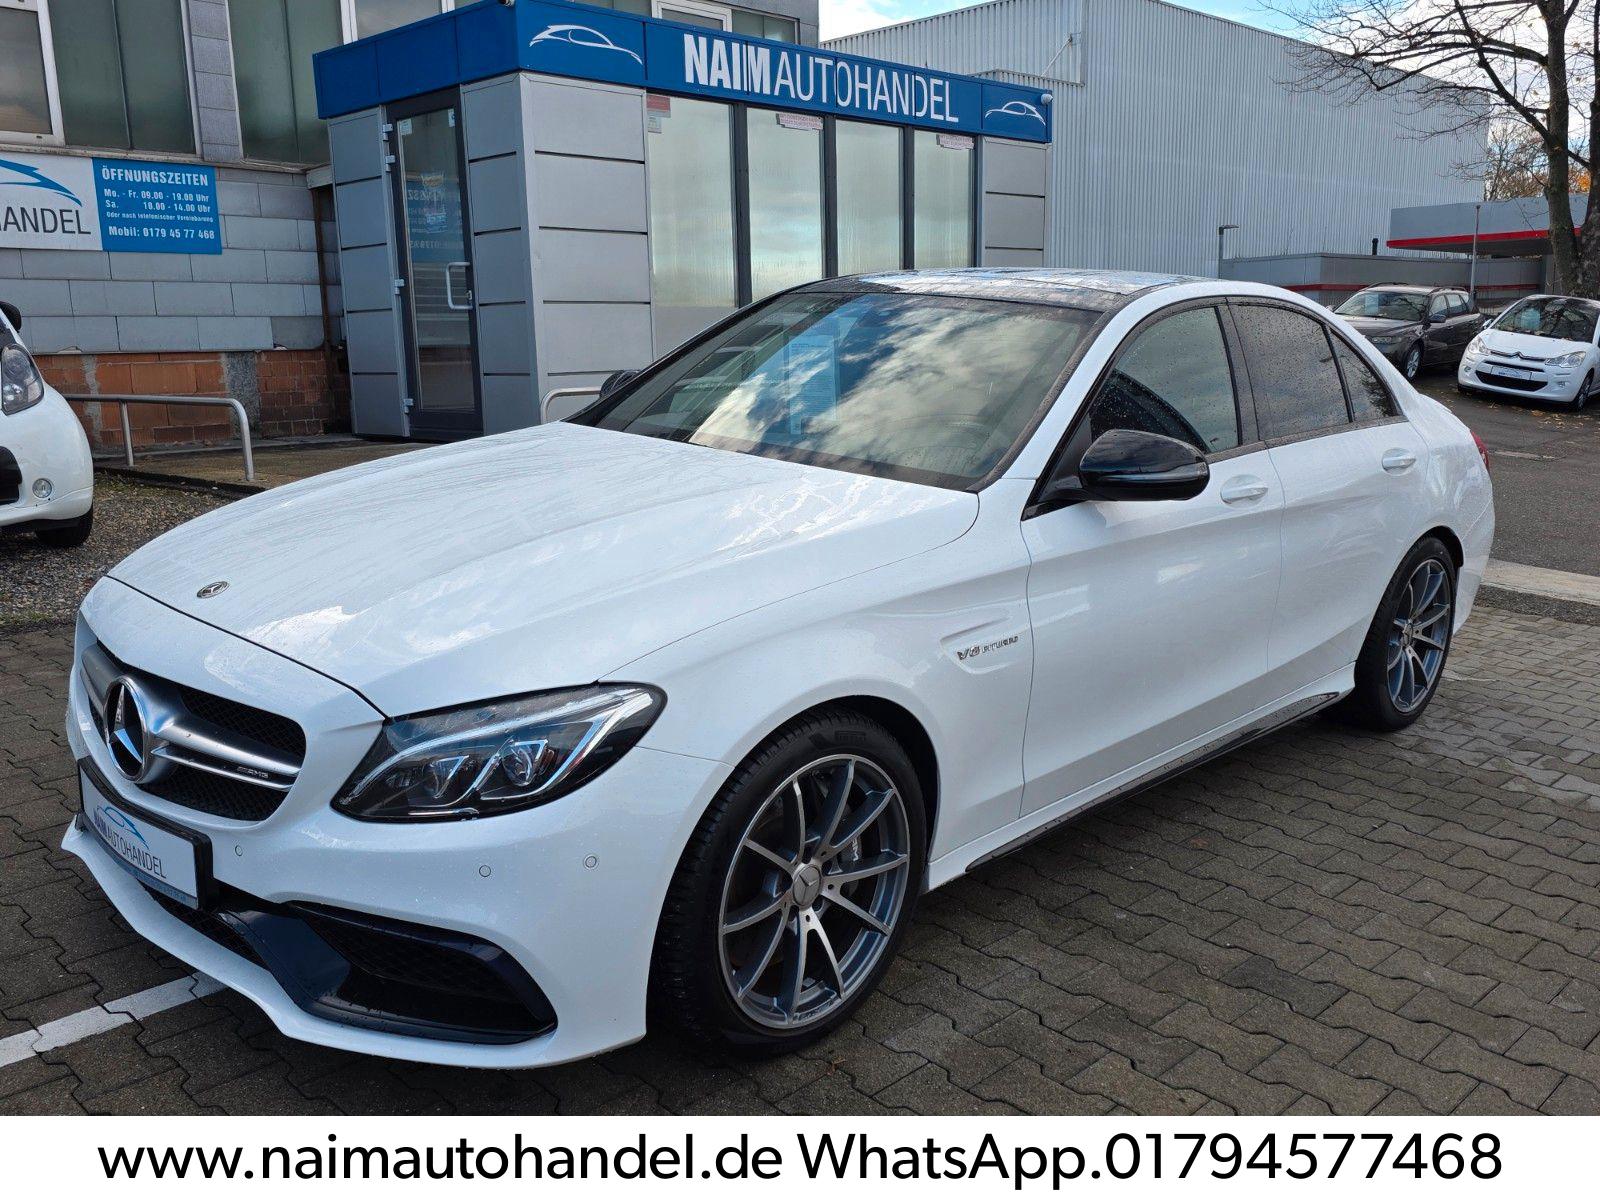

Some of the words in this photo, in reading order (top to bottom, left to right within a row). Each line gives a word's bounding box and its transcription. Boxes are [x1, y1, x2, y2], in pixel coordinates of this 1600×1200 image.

[683, 33, 771, 95] NAIM
[774, 51, 960, 123] AUTOHANDEL
[101, 164, 209, 187] ÖFFNUNGSZEITEN
[104, 188, 120, 198] Mo.
[128, 189, 139, 198] Fr.
[141, 190, 164, 200] 09.00
[196, 193, 209, 203] Uhr
[105, 199, 119, 209] Sa.
[143, 201, 166, 211] 10.00
[174, 203, 196, 213] 14.00
[197, 204, 211, 213] Uhr
[106, 211, 120, 219] Oder
[0, 206, 92, 235] ANDEL
[108, 225, 140, 237] Mobil:
[143, 227, 167, 238] 0179
[169, 229, 181, 239] 45
[184, 230, 195, 240] 77
[198, 230, 215, 240] 468
[107, 827, 167, 879] AUTOHANDEL
